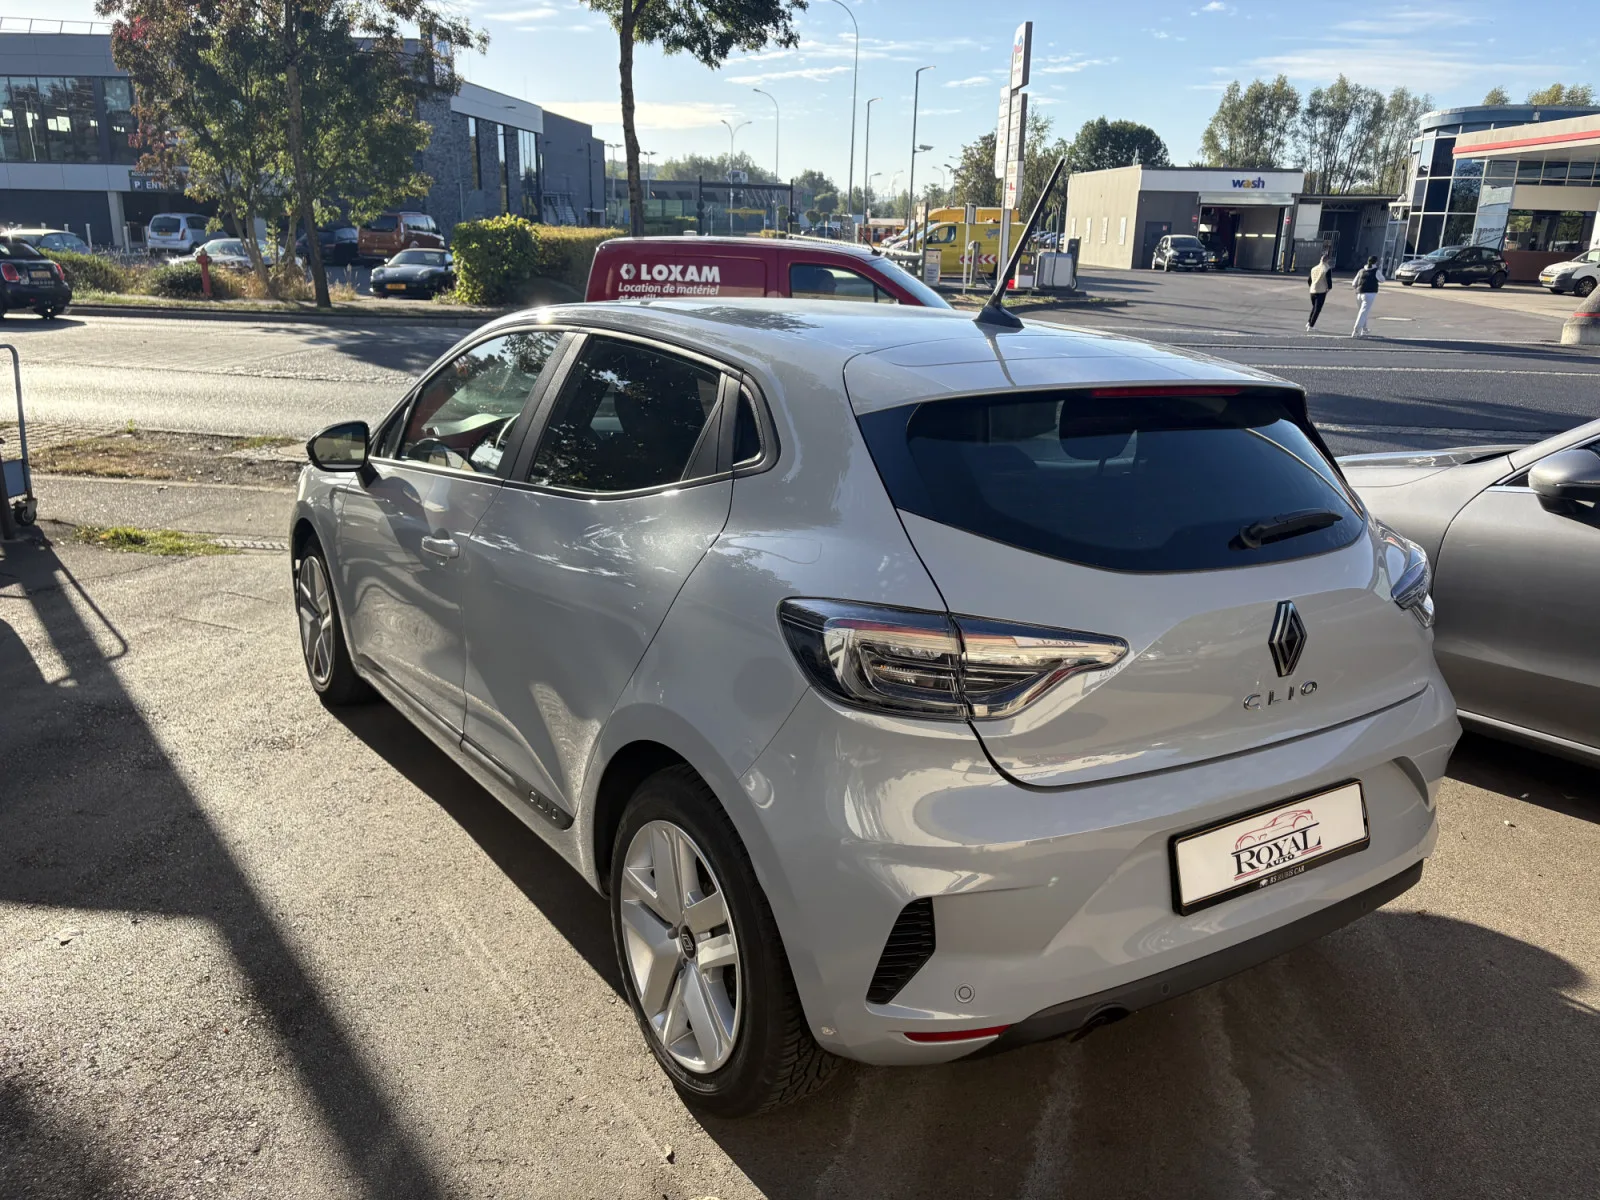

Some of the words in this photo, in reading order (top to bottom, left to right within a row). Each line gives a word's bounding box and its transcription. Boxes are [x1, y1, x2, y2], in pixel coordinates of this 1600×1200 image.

[1232, 177, 1265, 188] wash
[641, 264, 720, 282] LOXAM
[618, 282, 661, 293] Location
[662, 283, 676, 294] de
[676, 284, 720, 296] matériel
[1244, 681, 1317, 710] CLIO
[528, 791, 558, 820] CLIO
[1233, 829, 1321, 876] ROYAL
[1265, 854, 1295, 869] AUTO
[1293, 865, 1305, 875] CAR
